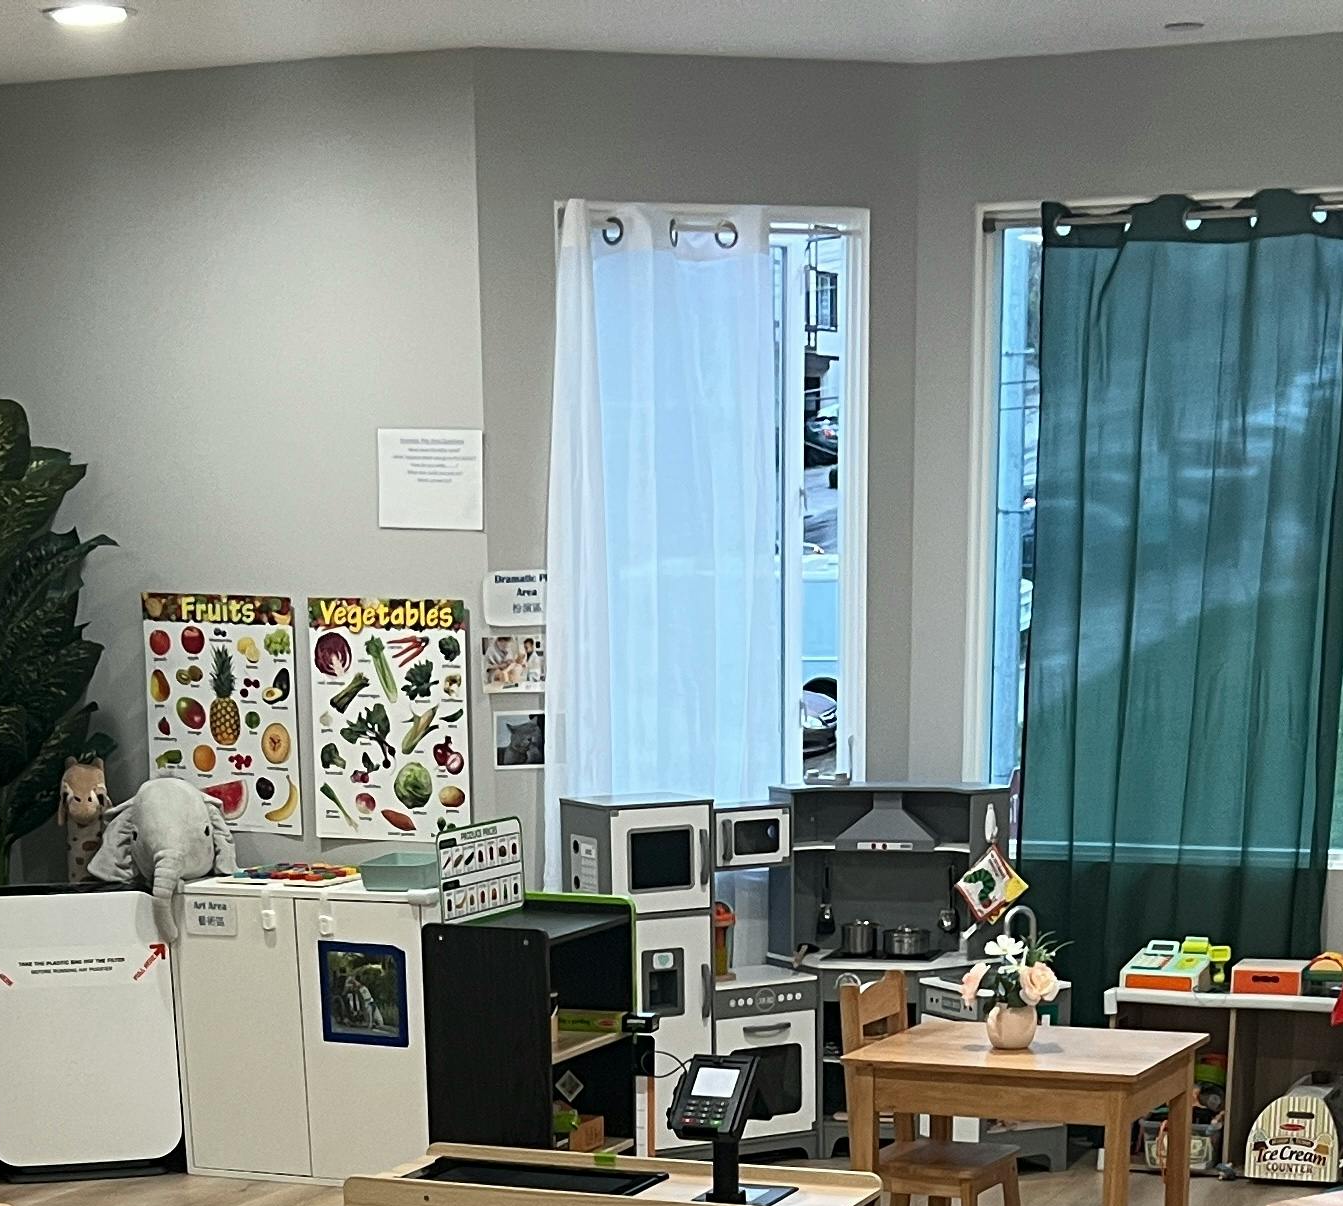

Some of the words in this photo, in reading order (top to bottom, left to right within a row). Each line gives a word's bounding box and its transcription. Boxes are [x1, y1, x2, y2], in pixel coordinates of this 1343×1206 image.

[494, 574, 536, 584] Dramatic
[516, 588, 537, 596] Area
[180, 596, 256, 624] Fruits
[320, 600, 454, 633] Vegetables
[194, 901, 206, 910] Art
[208, 902, 227, 910] Area
[1257, 1148, 1279, 1162] Ice
[1280, 1146, 1326, 1166] Cream
[1266, 1162, 1313, 1173] COUNTER
